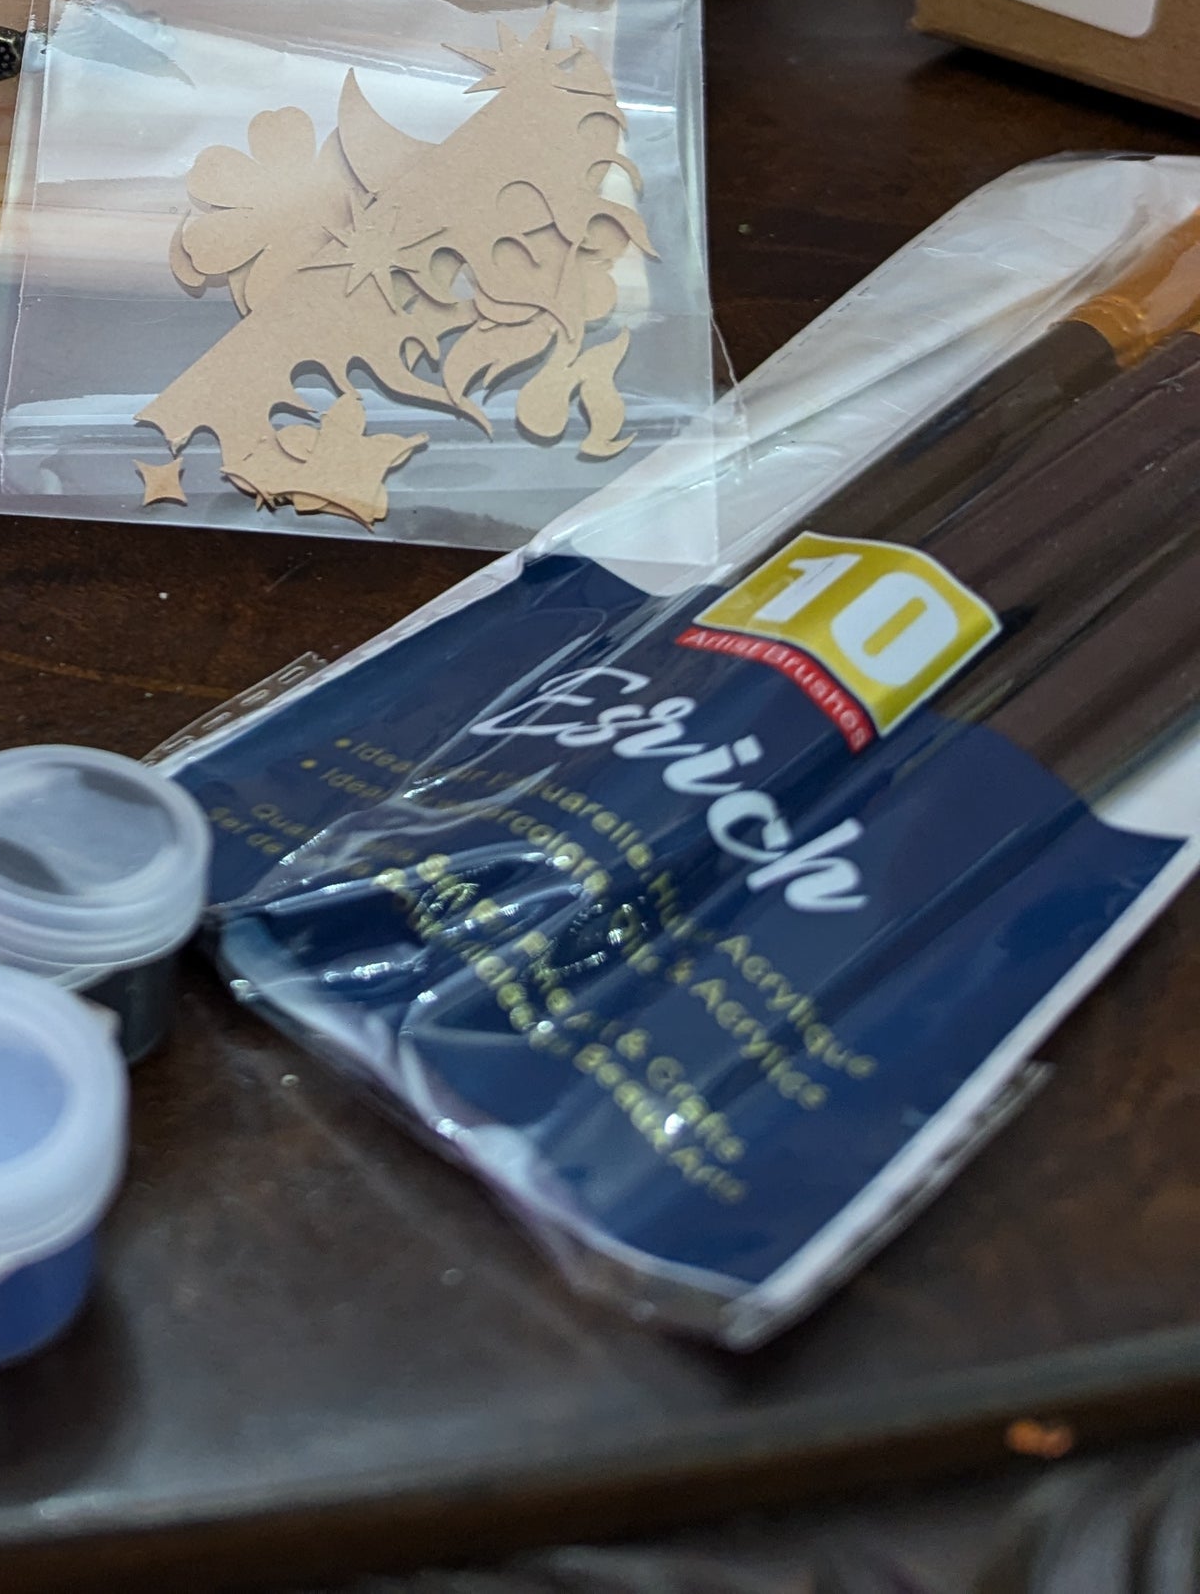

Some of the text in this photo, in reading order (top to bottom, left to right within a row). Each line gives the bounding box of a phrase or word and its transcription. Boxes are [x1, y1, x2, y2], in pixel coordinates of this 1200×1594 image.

[754, 552, 959, 688] 10
[762, 643, 867, 753] Brushes
[468, 664, 868, 912] Esrich
